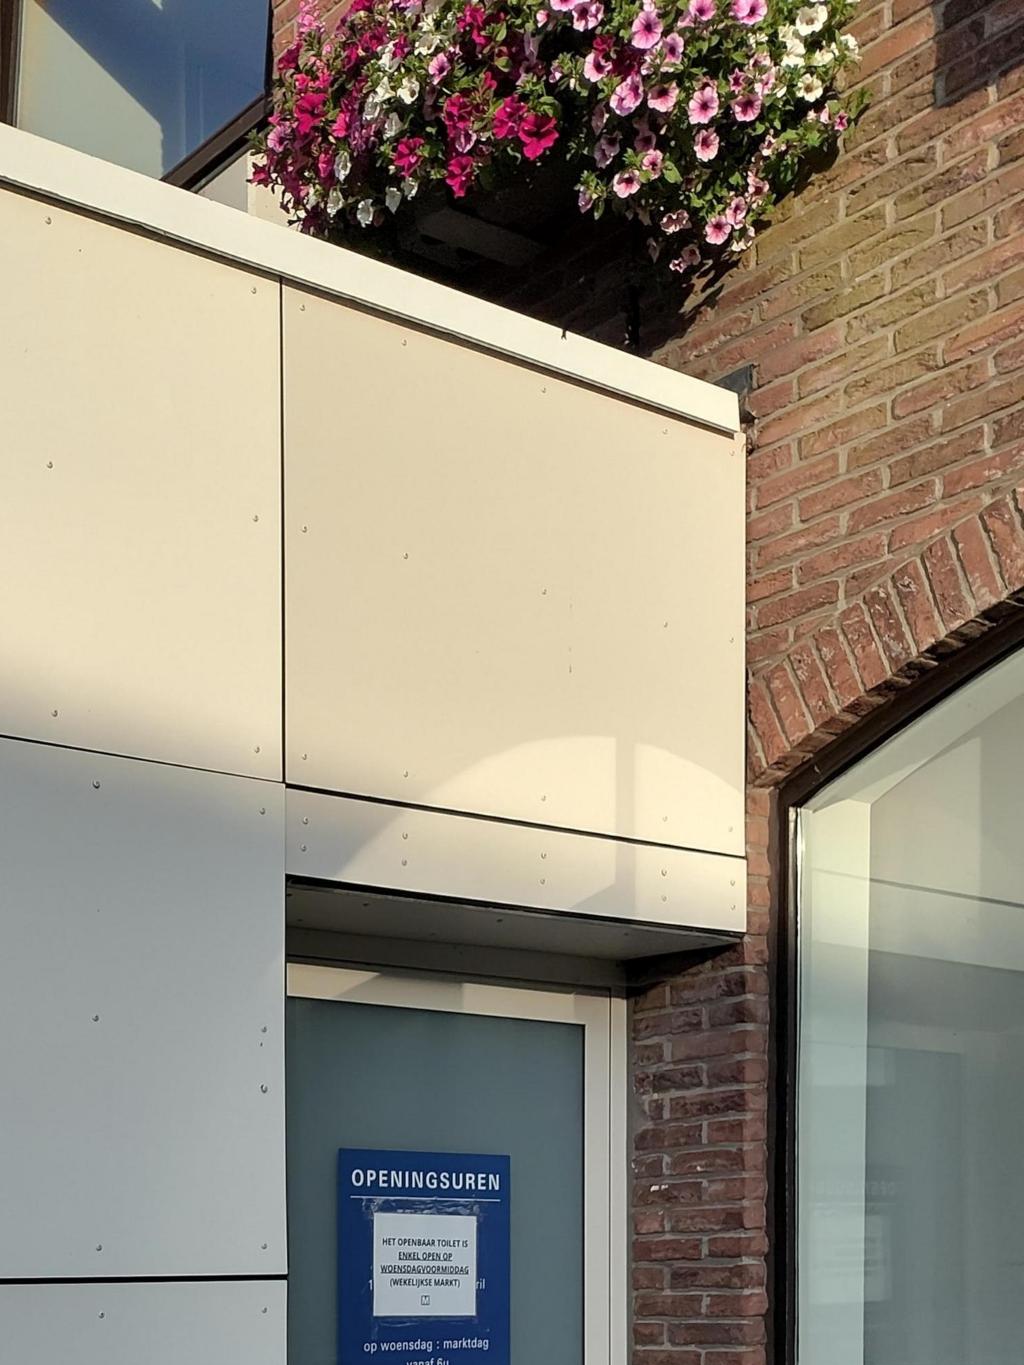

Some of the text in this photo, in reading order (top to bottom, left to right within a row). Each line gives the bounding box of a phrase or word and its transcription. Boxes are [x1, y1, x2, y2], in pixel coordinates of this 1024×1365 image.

[351, 1169, 500, 1191] OPENINGSUREN
[382, 1237, 469, 1248] HET OPENBAAR TOILET IS
[398, 1251, 453, 1261] ENKEL OPEN OP
[380, 1264, 470, 1275] WOENSDAGVOORMIDDAG
[433, 1279, 461, 1288] MARKT)
[363, 1342, 378, 1354] op
[380, 1338, 433, 1354] woensdag
[443, 1337, 490, 1351] marktdag
